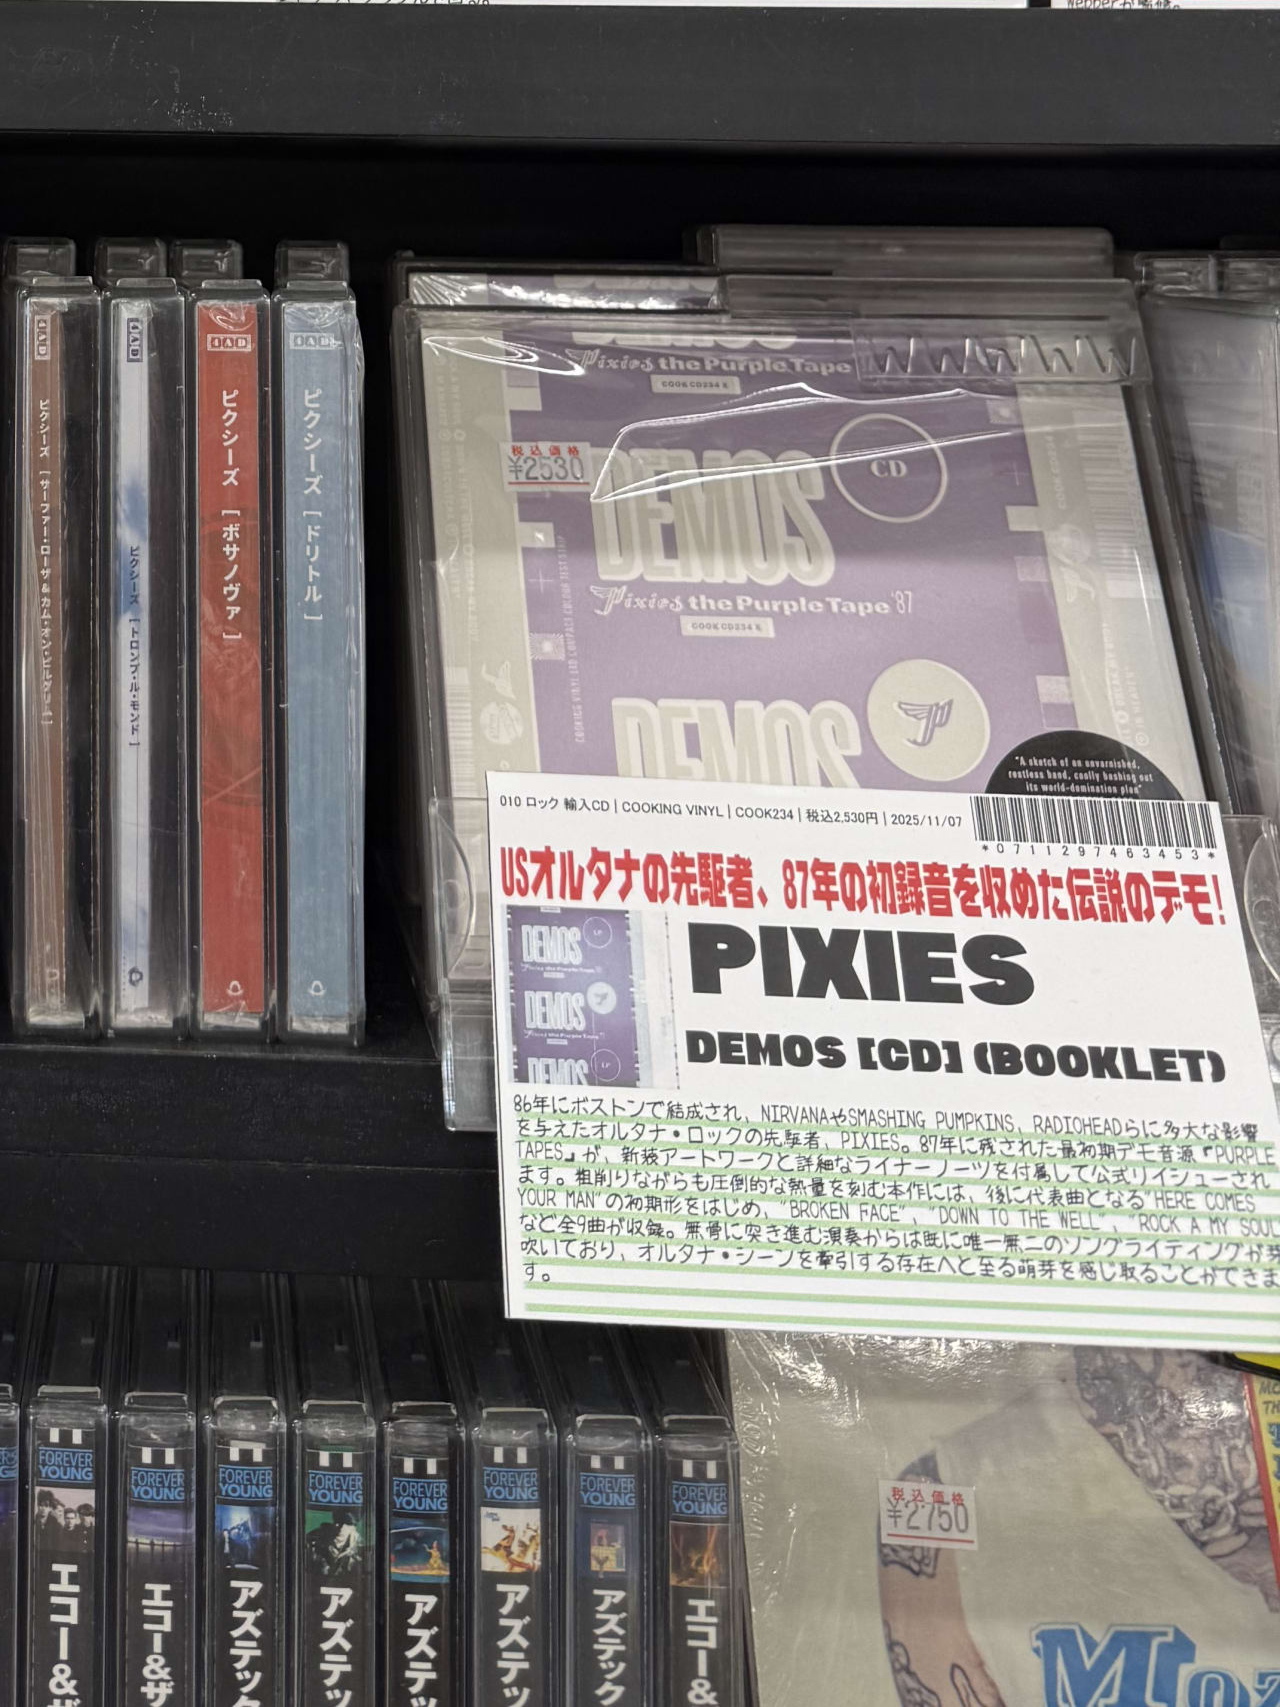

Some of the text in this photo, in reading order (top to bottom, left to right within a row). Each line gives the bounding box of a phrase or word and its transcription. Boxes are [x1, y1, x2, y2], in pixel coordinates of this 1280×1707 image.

[221, 389, 240, 487] ピクシーズ
[508, 455, 584, 482] ¥2530
[870, 459, 908, 479] CD
[591, 449, 836, 586] DEMOS
[128, 546, 140, 606] ピクシーズ
[590, 585, 683, 615] Pixies
[688, 597, 733, 613] the
[736, 598, 824, 617] Purple
[826, 598, 890, 616] Tape
[622, 802, 682, 814] COOKING
[686, 805, 723, 817] VINYL
[736, 807, 793, 819] COOK234
[891, 814, 961, 827] 2025/11/07
[688, 922, 1034, 1005] PIXIES
[686, 1030, 1225, 1082] DEMOS [CD] (BOOKLET)
[518, 1189, 556, 1207] YOUR
[483, 1470, 538, 1487] FOREVER
[484, 1486, 538, 1500] YOUNG
[887, 1499, 969, 1533] ¥2750
